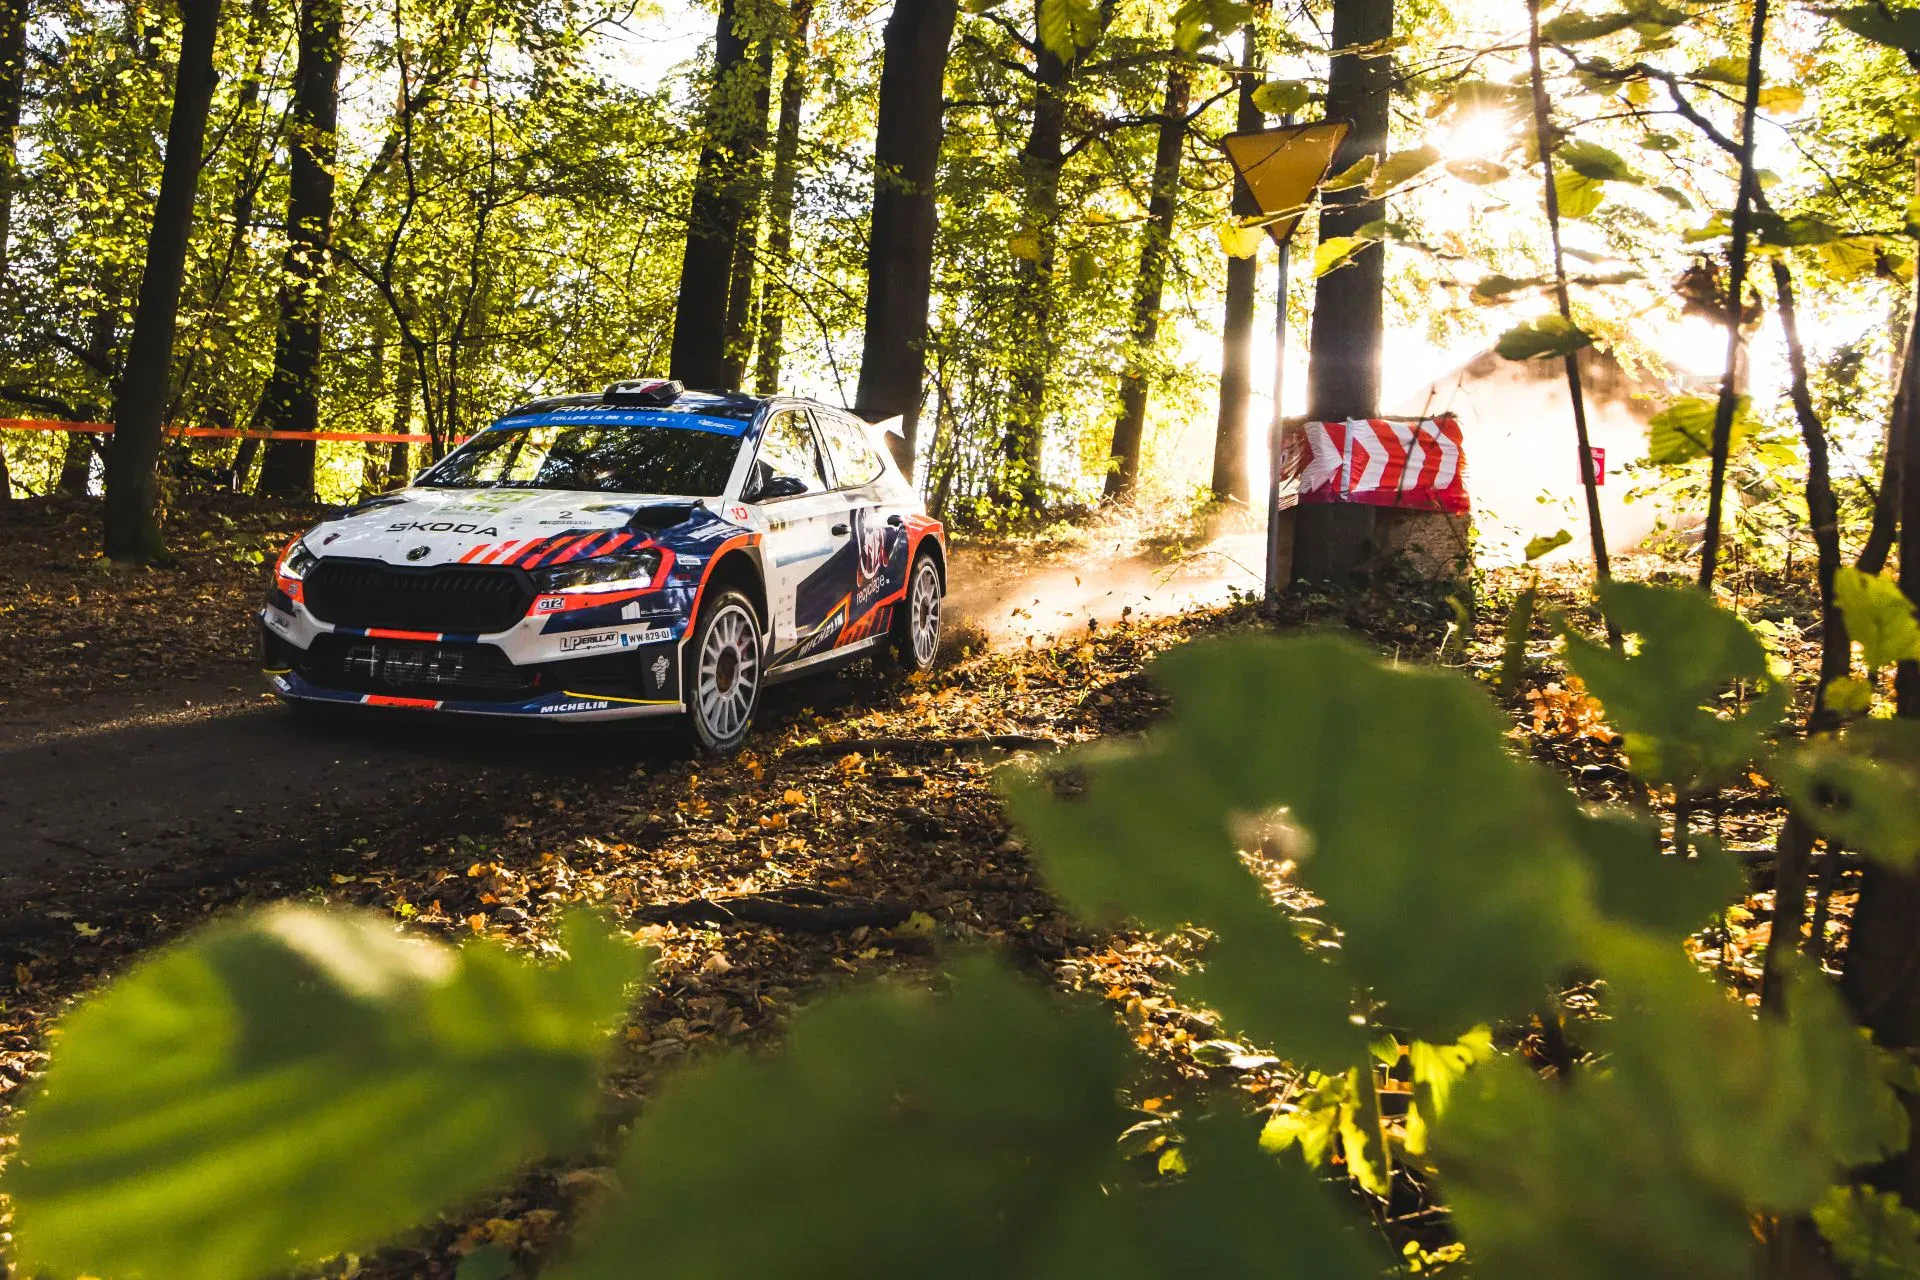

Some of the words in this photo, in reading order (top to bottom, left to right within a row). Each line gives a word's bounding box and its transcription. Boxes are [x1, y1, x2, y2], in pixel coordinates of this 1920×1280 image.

[558, 510, 573, 519] 2
[797, 612, 844, 658] MICHELIN
[540, 701, 608, 713] MICHELIN
